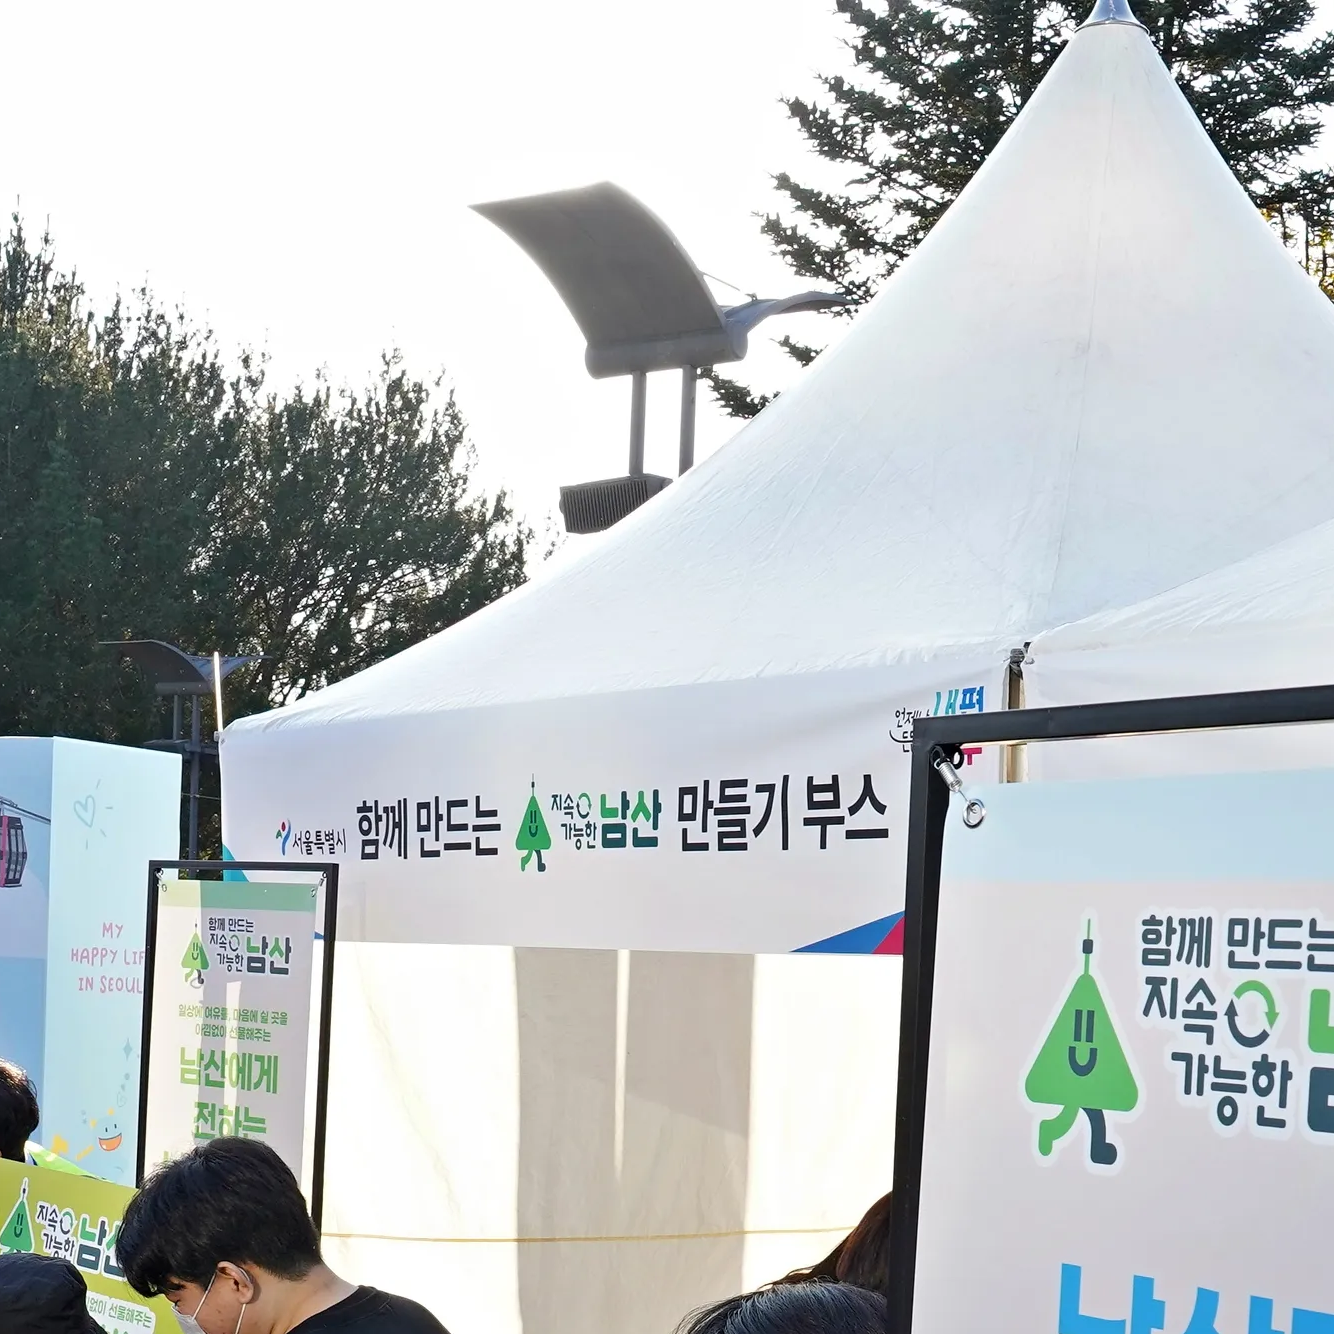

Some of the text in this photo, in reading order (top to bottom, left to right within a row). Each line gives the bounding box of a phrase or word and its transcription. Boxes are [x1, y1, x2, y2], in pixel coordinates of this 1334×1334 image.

[292, 774, 889, 860] 서울특별시 함께 만드는 지속 가능한 남산 만들기 부스
[102, 922, 123, 938] MY
[208, 917, 254, 933] 함께 만드는
[209, 933, 227, 951] 지속
[246, 936, 292, 975] 남산
[1141, 914, 1213, 968] 함께
[71, 947, 146, 967] HAPPY LIF
[217, 953, 244, 972] 가능한
[78, 975, 142, 994] IN SEOUL
[1142, 976, 1218, 1046] 지속
[229, 1026, 271, 1042] 선물해주는
[180, 1047, 278, 1094] 남산에게
[1171, 1051, 1294, 1129] 가능한
[194, 1102, 266, 1139] 전하는
[37, 1204, 61, 1232] 지속
[87, 1296, 153, 1329] 없이 선물해주는
